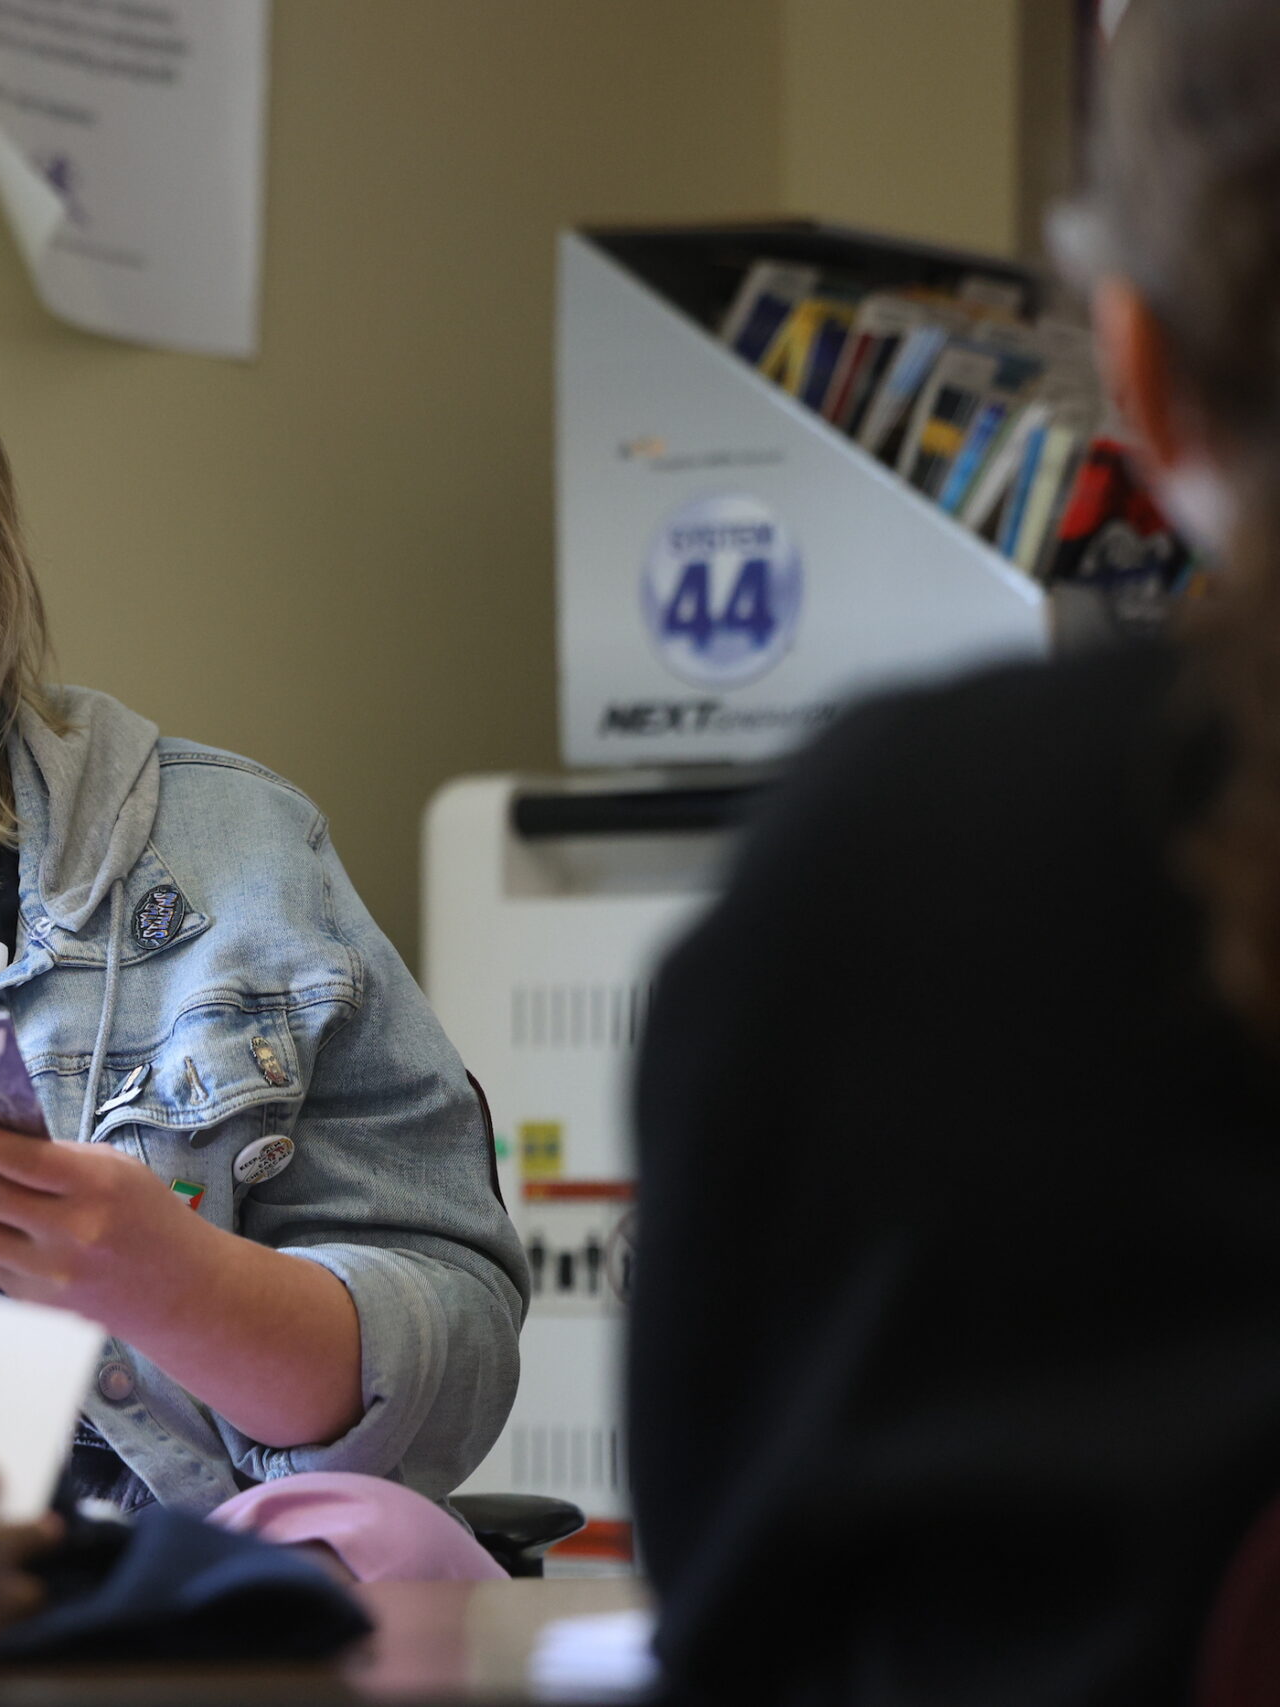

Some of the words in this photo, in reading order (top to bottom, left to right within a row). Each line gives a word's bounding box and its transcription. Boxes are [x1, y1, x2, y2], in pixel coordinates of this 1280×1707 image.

[662, 559, 777, 651] 44
[598, 702, 721, 738] NEXT
[239, 1157, 258, 1171] KEEP
